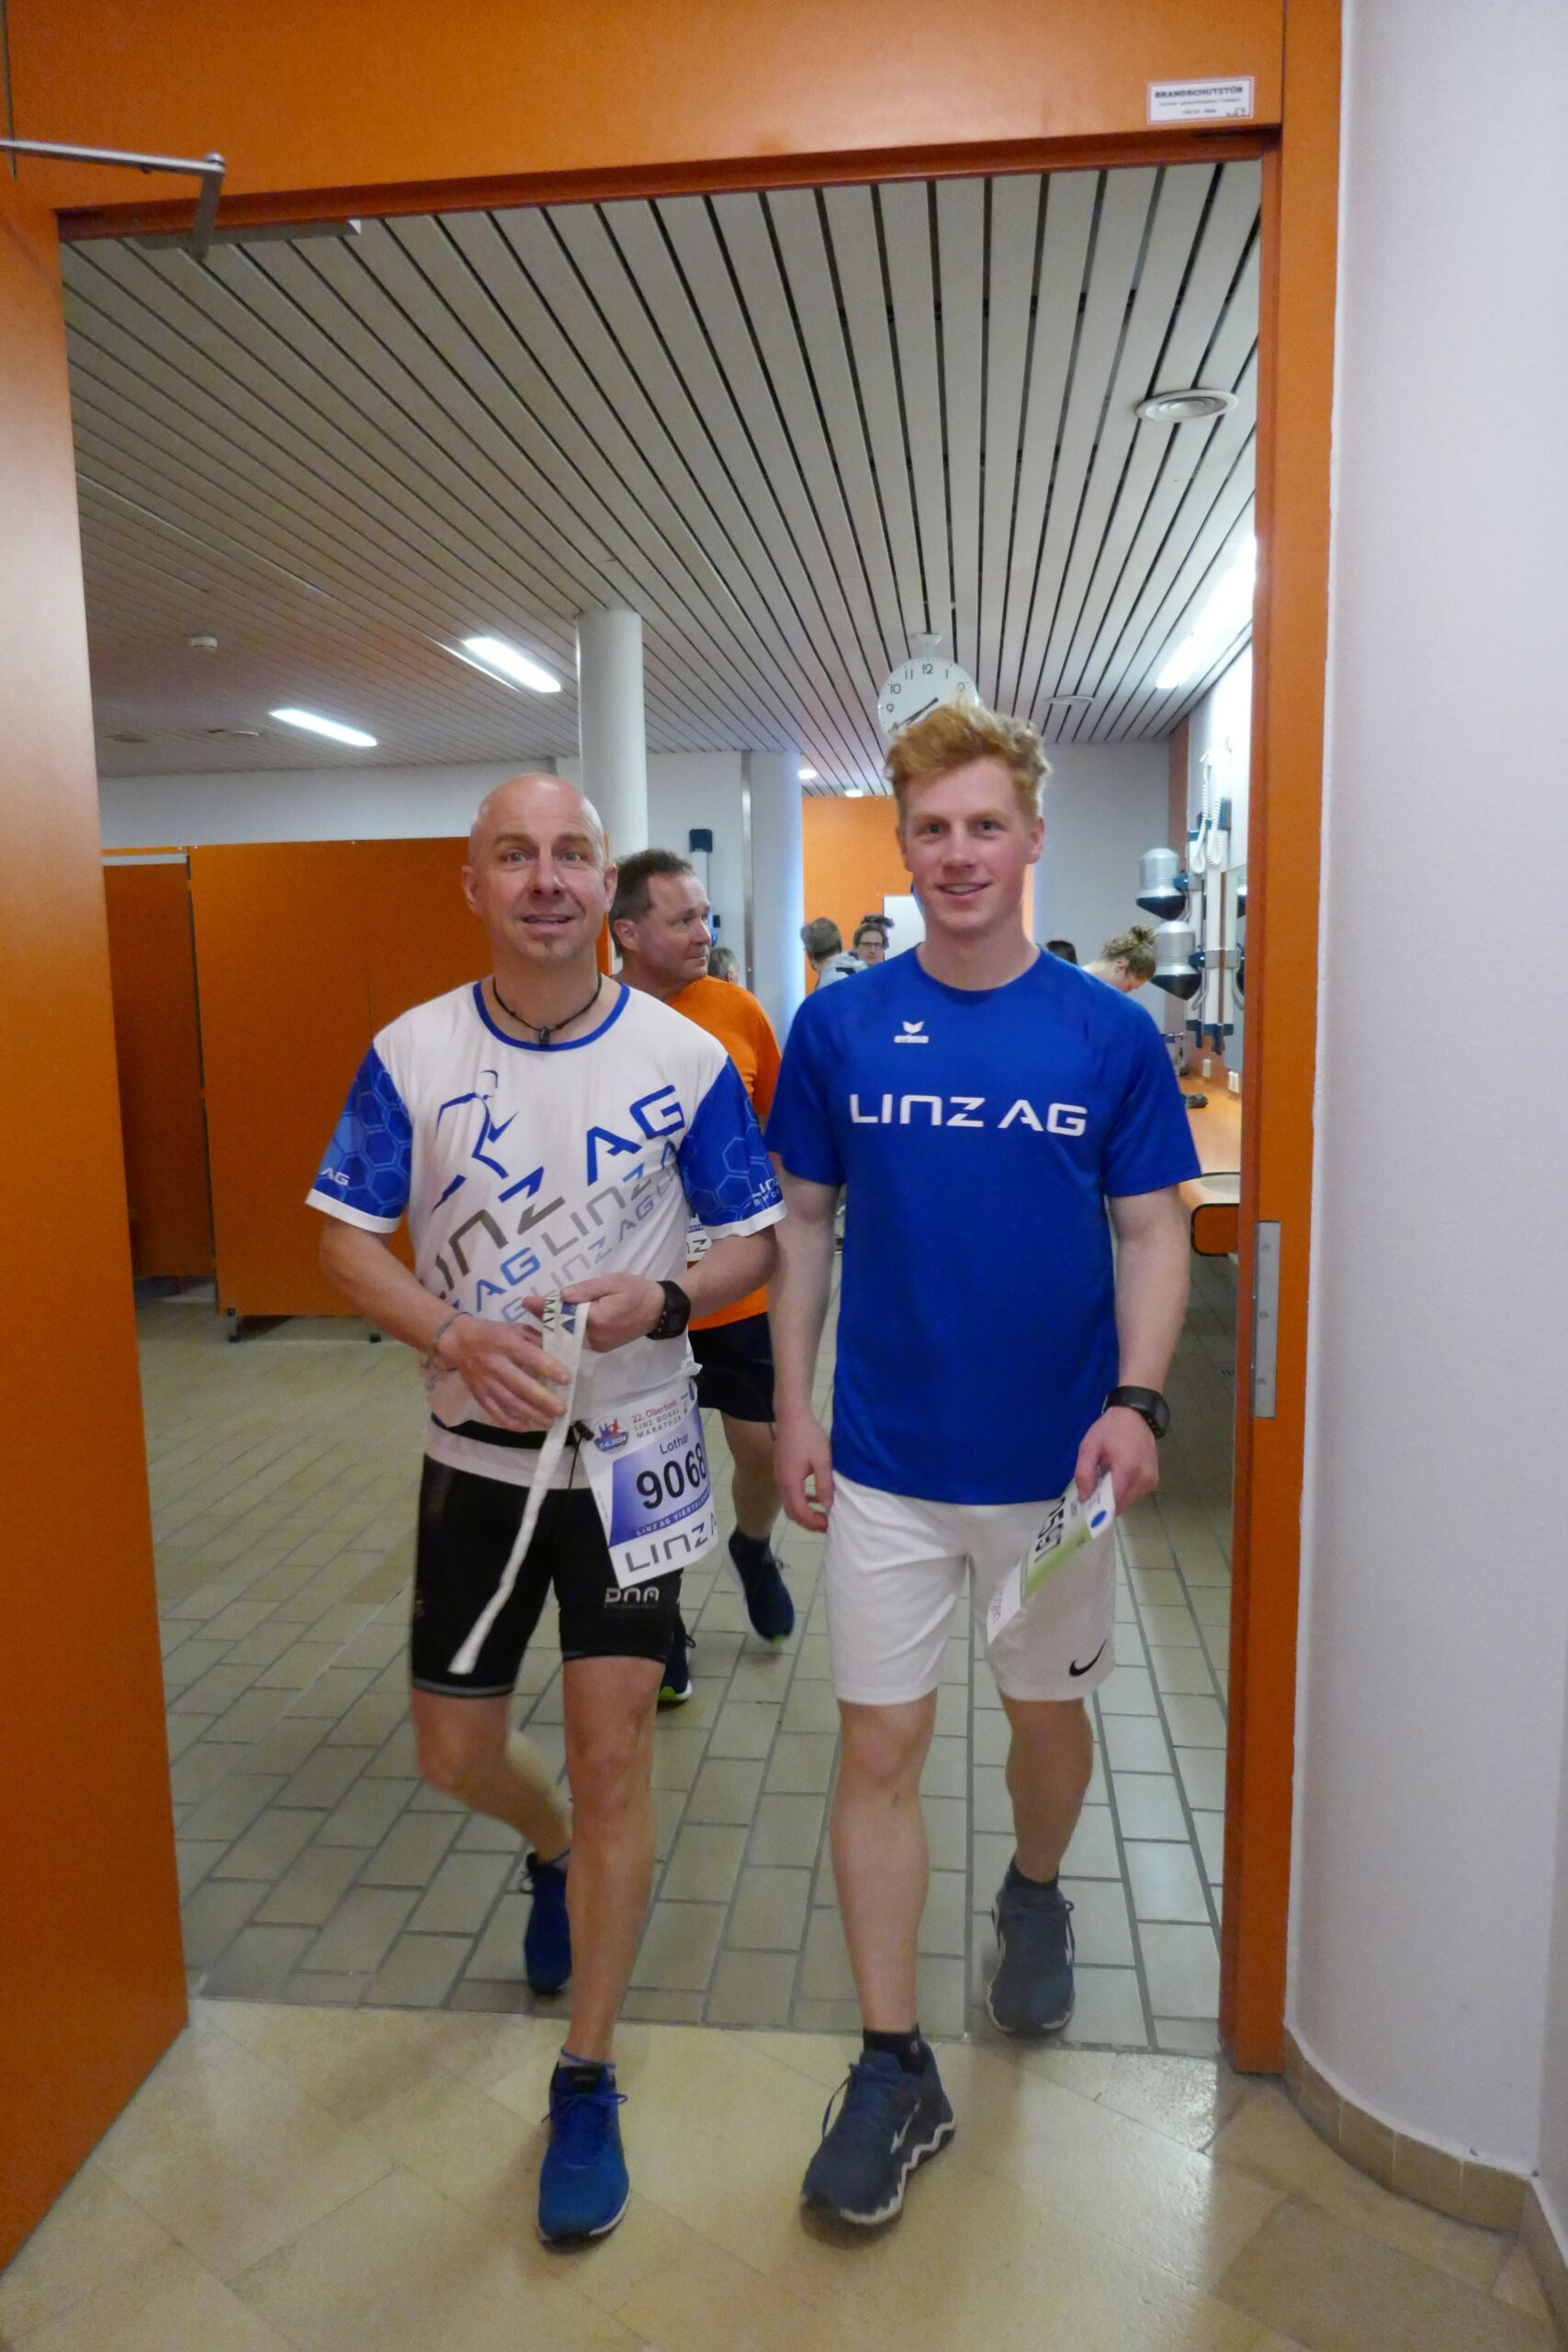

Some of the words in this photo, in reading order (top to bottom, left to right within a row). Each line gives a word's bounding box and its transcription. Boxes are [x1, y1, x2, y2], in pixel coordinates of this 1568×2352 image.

[905, 669, 914, 680] 11
[922, 663, 934, 675] 12
[890, 684, 902, 695] 10
[886, 703, 895, 714] 9
[849, 1093, 987, 1128] LINZ
[997, 1098, 1089, 1137] AG
[586, 1084, 686, 1187] AG
[320, 1166, 352, 1187] AG
[636, 1442, 707, 1510] 9068
[604, 1586, 660, 1603] DNA
